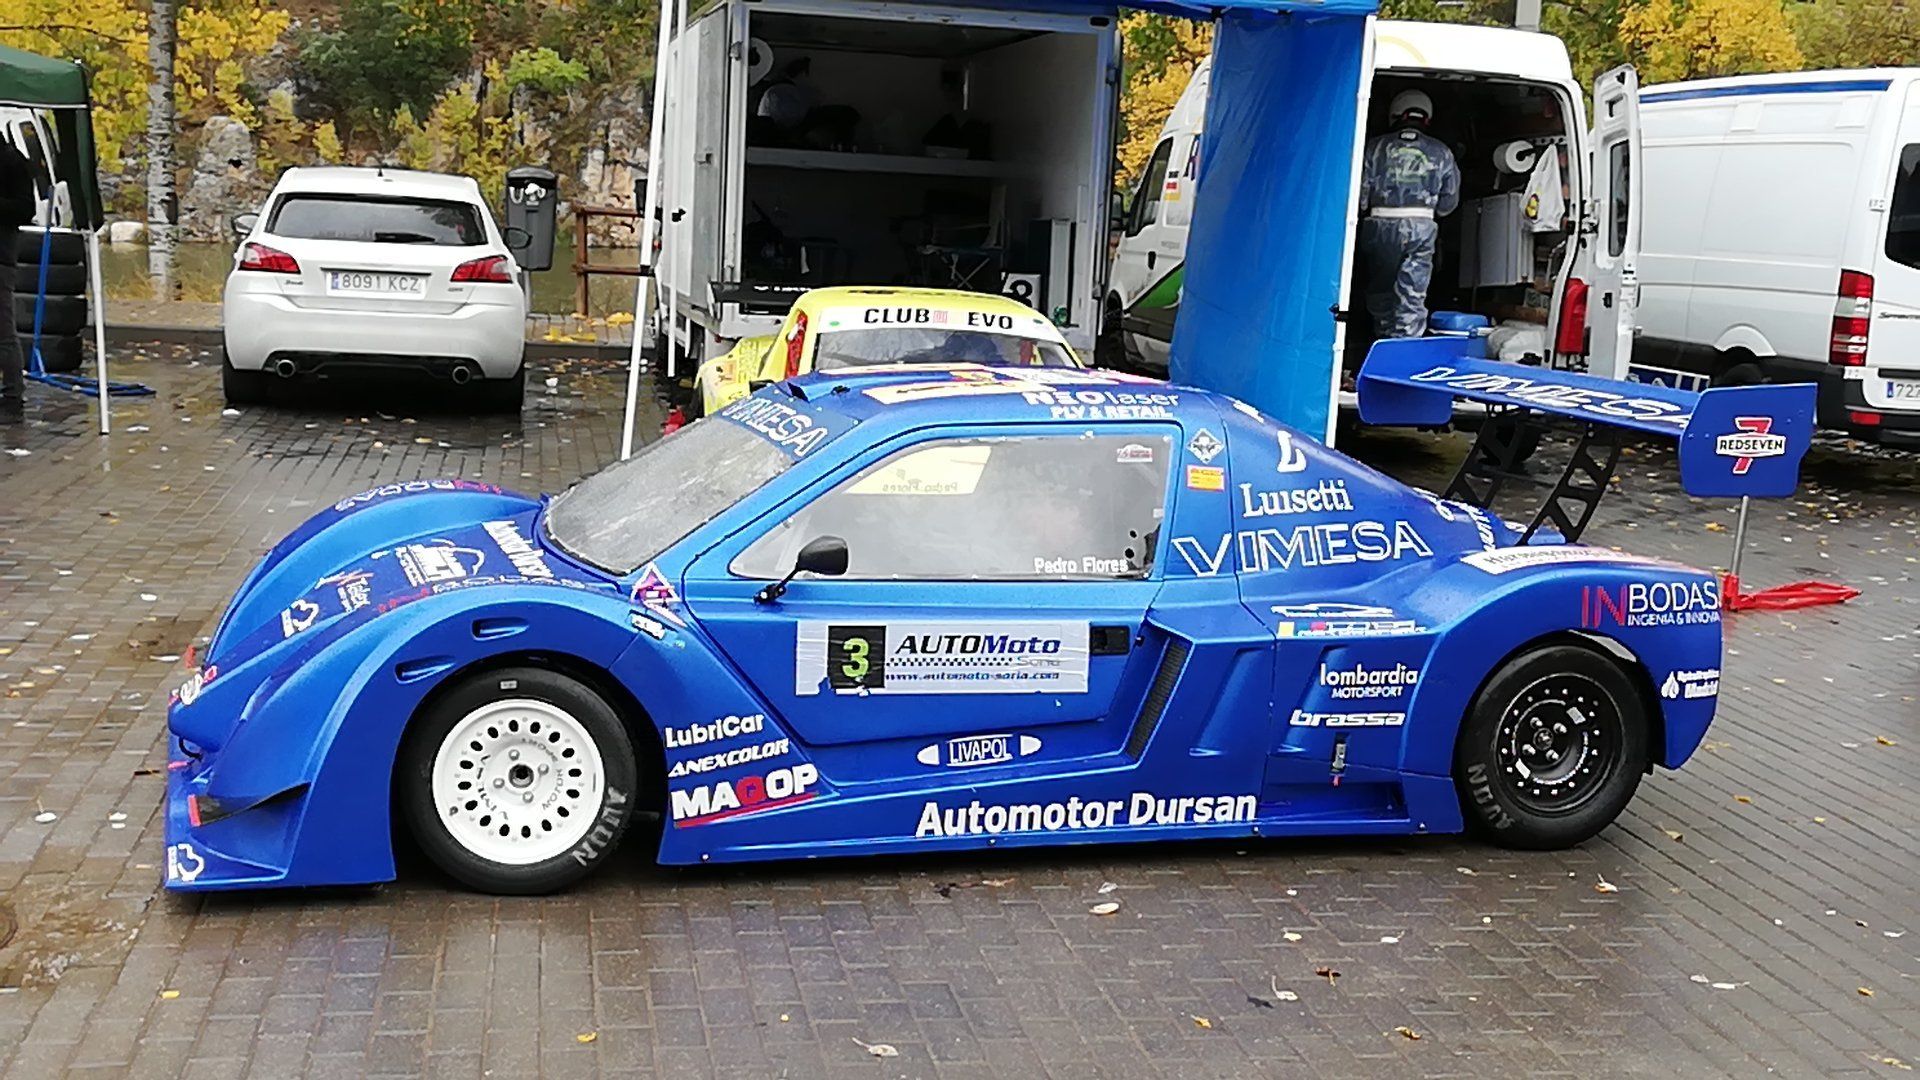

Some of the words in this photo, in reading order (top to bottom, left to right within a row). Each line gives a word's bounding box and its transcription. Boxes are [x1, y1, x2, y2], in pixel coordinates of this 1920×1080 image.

[342, 274, 382, 289] 8091
[388, 278, 420, 292] KCZ
[863, 308, 930, 323] CLUB
[967, 312, 1013, 329] EVO
[1104, 406, 1173, 419] RETAIL
[1719, 440, 1783, 450] REDSEVEN
[1239, 479, 1353, 517] Luisetti
[1171, 521, 1434, 577] VIMESA
[1034, 557, 1077, 574] Pedro
[1082, 556, 1129, 573] Flores
[1628, 614, 1675, 626] INGENIA
[895, 635, 1061, 654] AUTOMoto
[842, 637, 870, 678] 3
[1320, 663, 1418, 685] lombardia
[1331, 686, 1403, 698] MOTORSPORT
[1290, 709, 1406, 726] brassa
[665, 715, 764, 747] LubriCar
[668, 738, 789, 777] ANEXCOLOR
[950, 739, 1012, 763] LIVAPOL
[915, 793, 1123, 837] Automotor
[1129, 793, 1257, 825] Dursan
